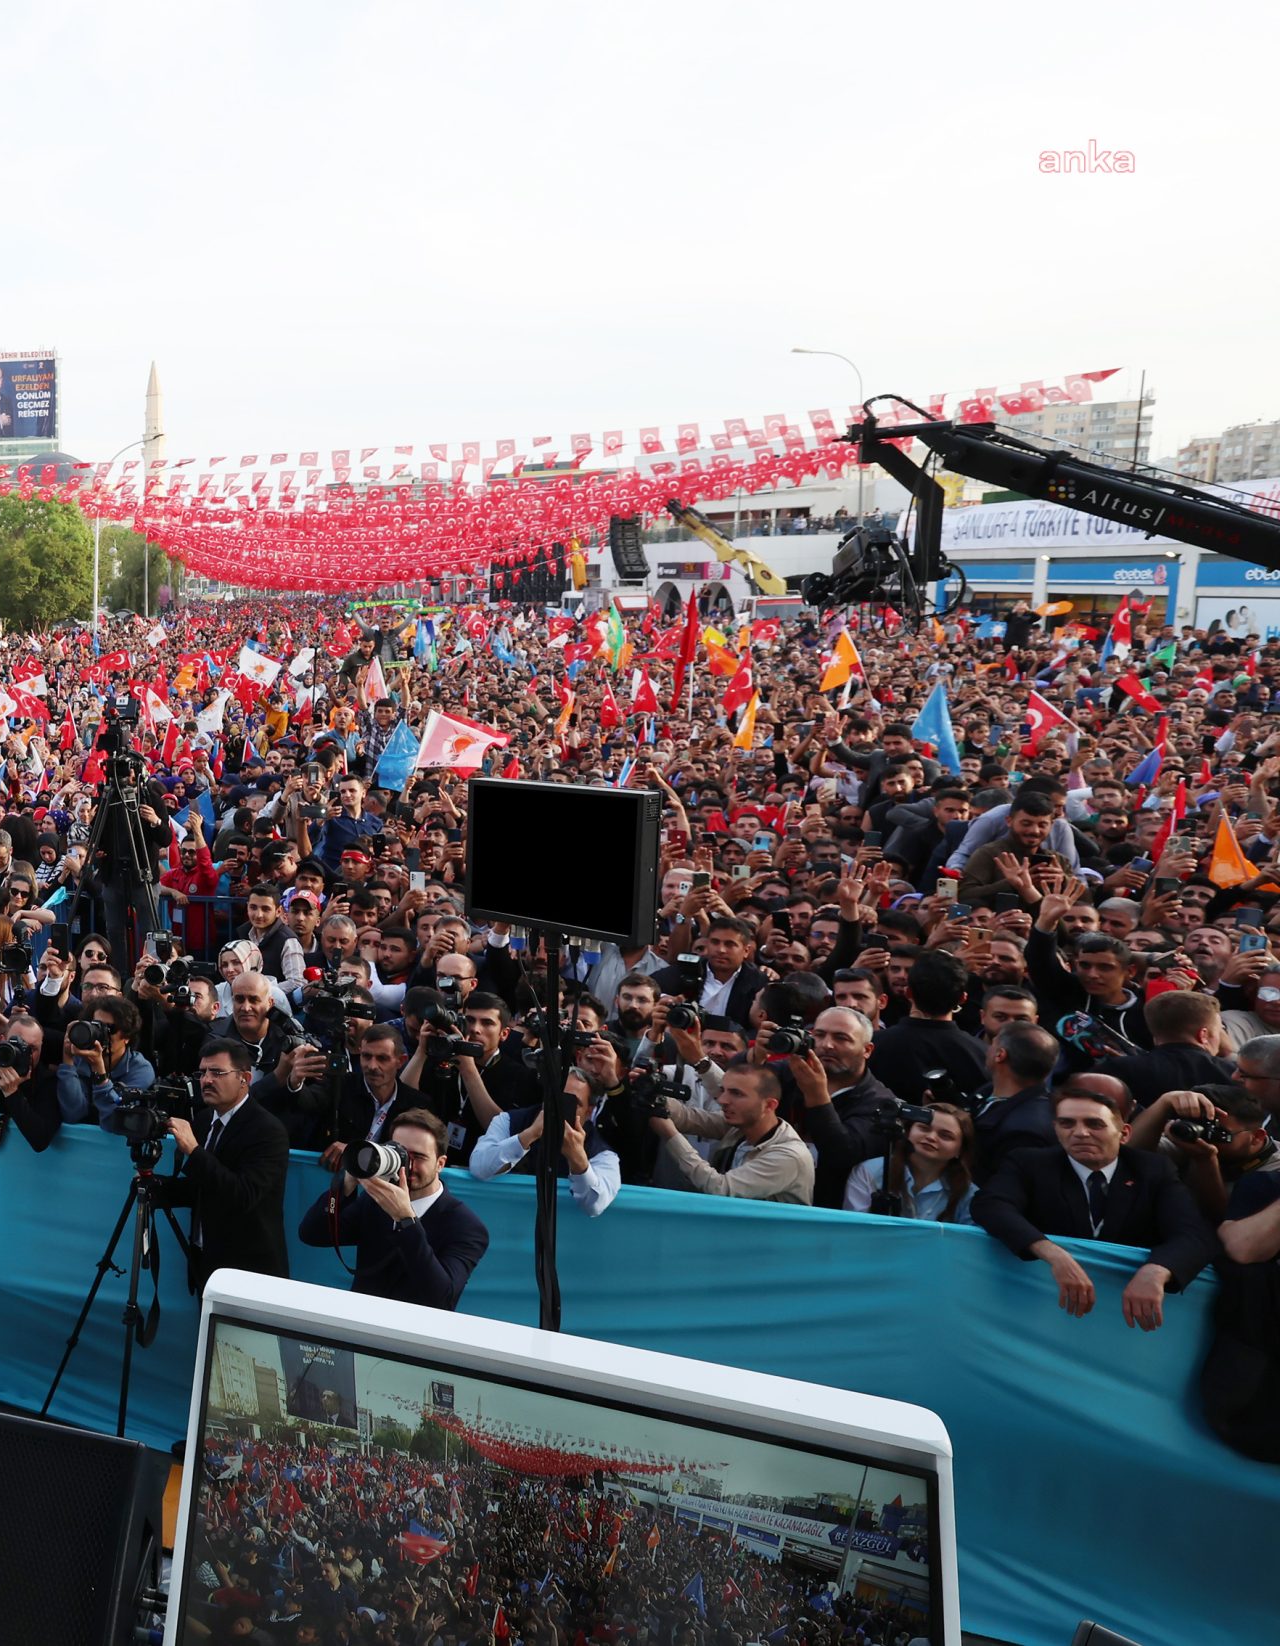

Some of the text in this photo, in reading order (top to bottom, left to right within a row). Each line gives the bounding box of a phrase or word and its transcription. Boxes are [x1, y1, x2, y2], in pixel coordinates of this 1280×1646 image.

[15, 383, 50, 392] EZELDEN
[15, 390, 51, 400] GÖNLÜM
[17, 400, 50, 410] GEÇMEZ
[17, 409, 49, 418] REİSTEN
[1082, 489, 1154, 520] Altus
[1113, 567, 1154, 580] ebebek
